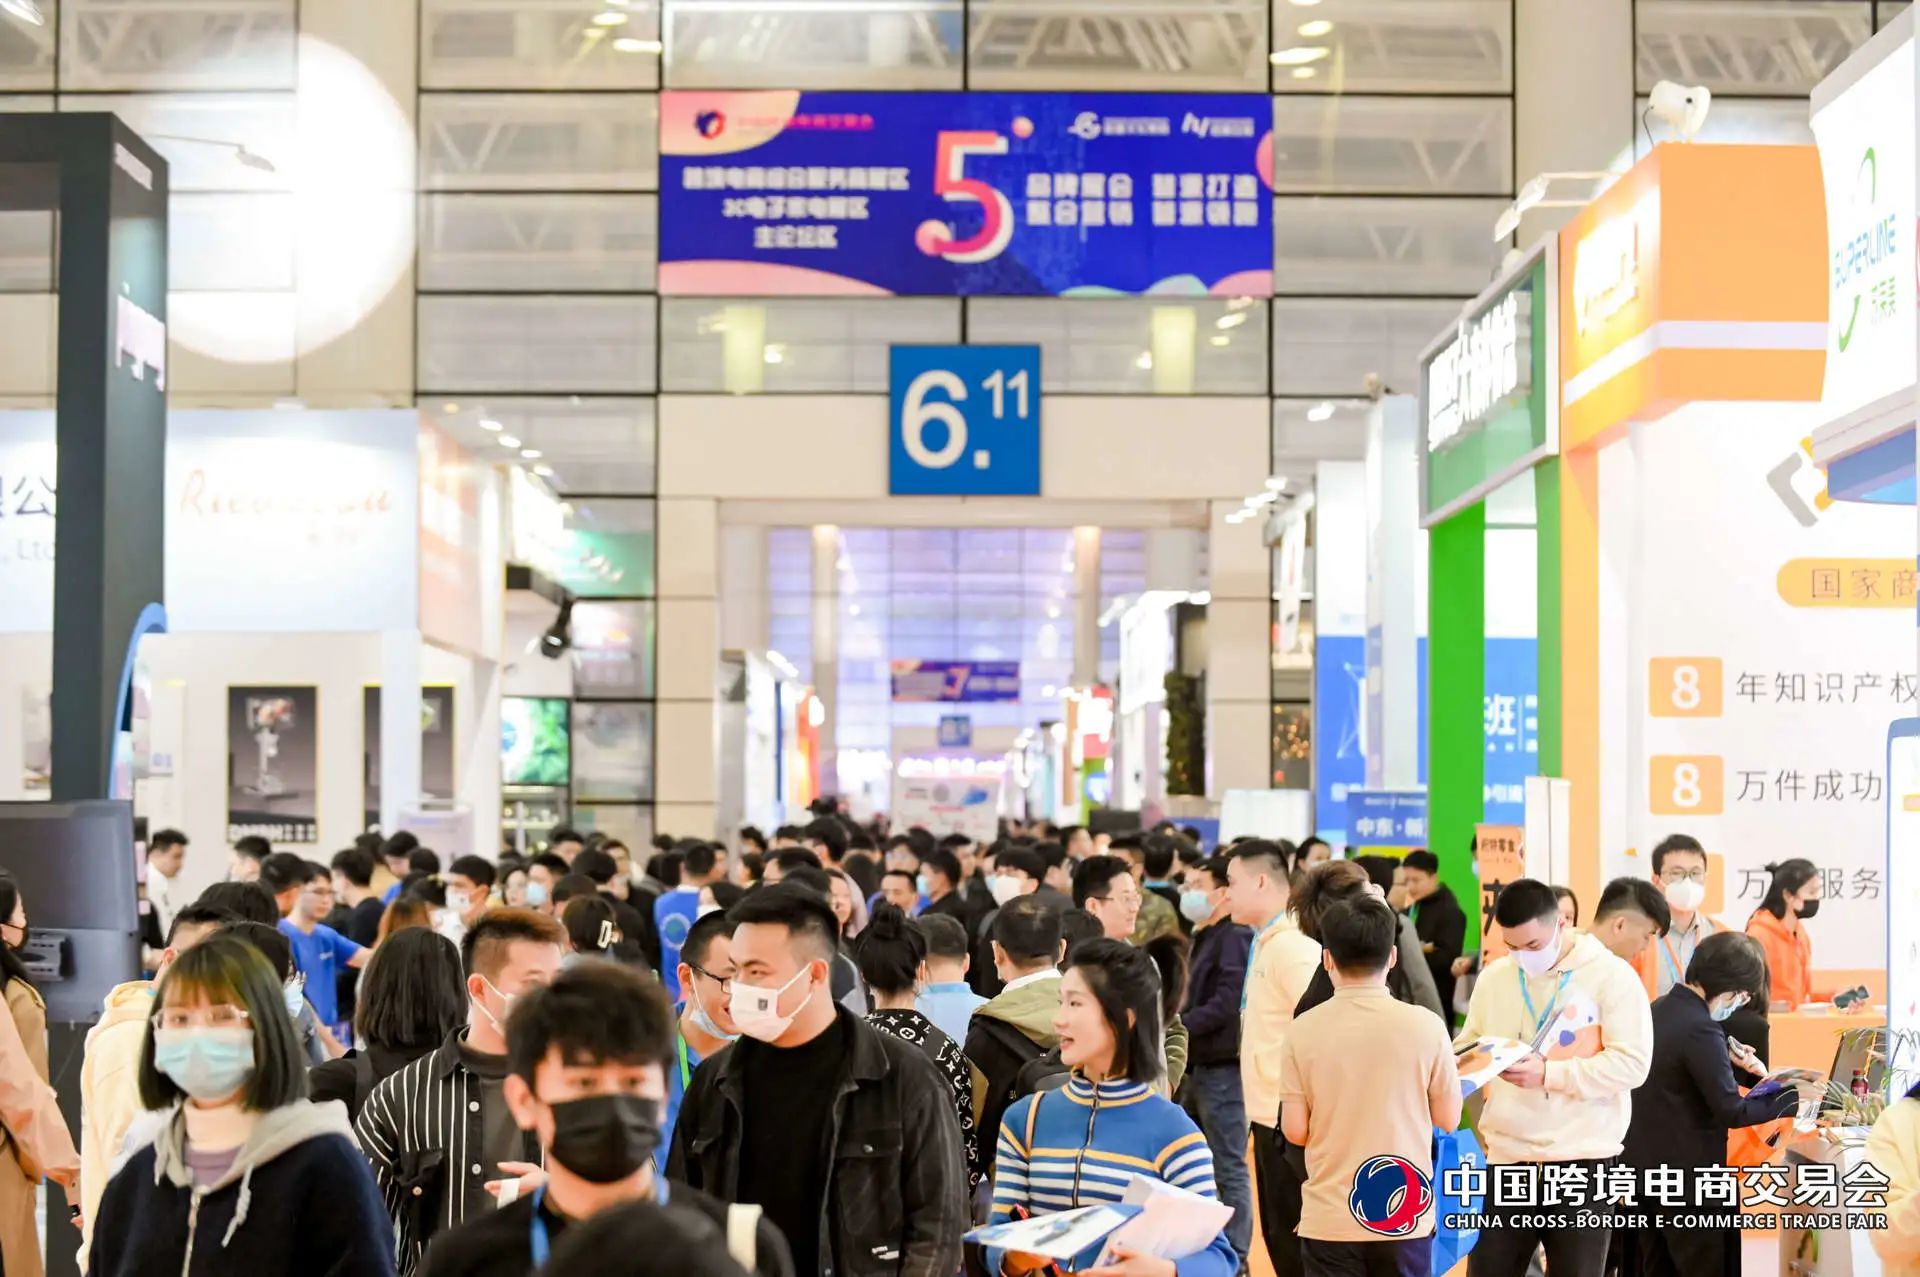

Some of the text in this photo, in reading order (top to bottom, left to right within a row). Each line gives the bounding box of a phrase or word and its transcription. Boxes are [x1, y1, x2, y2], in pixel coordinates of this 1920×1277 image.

[928, 130, 1015, 263] 5
[1671, 665, 1917, 710] 8 年知识产权
[1671, 763, 1882, 807] 8 万件成功
[1736, 867, 1882, 901] 万服务
